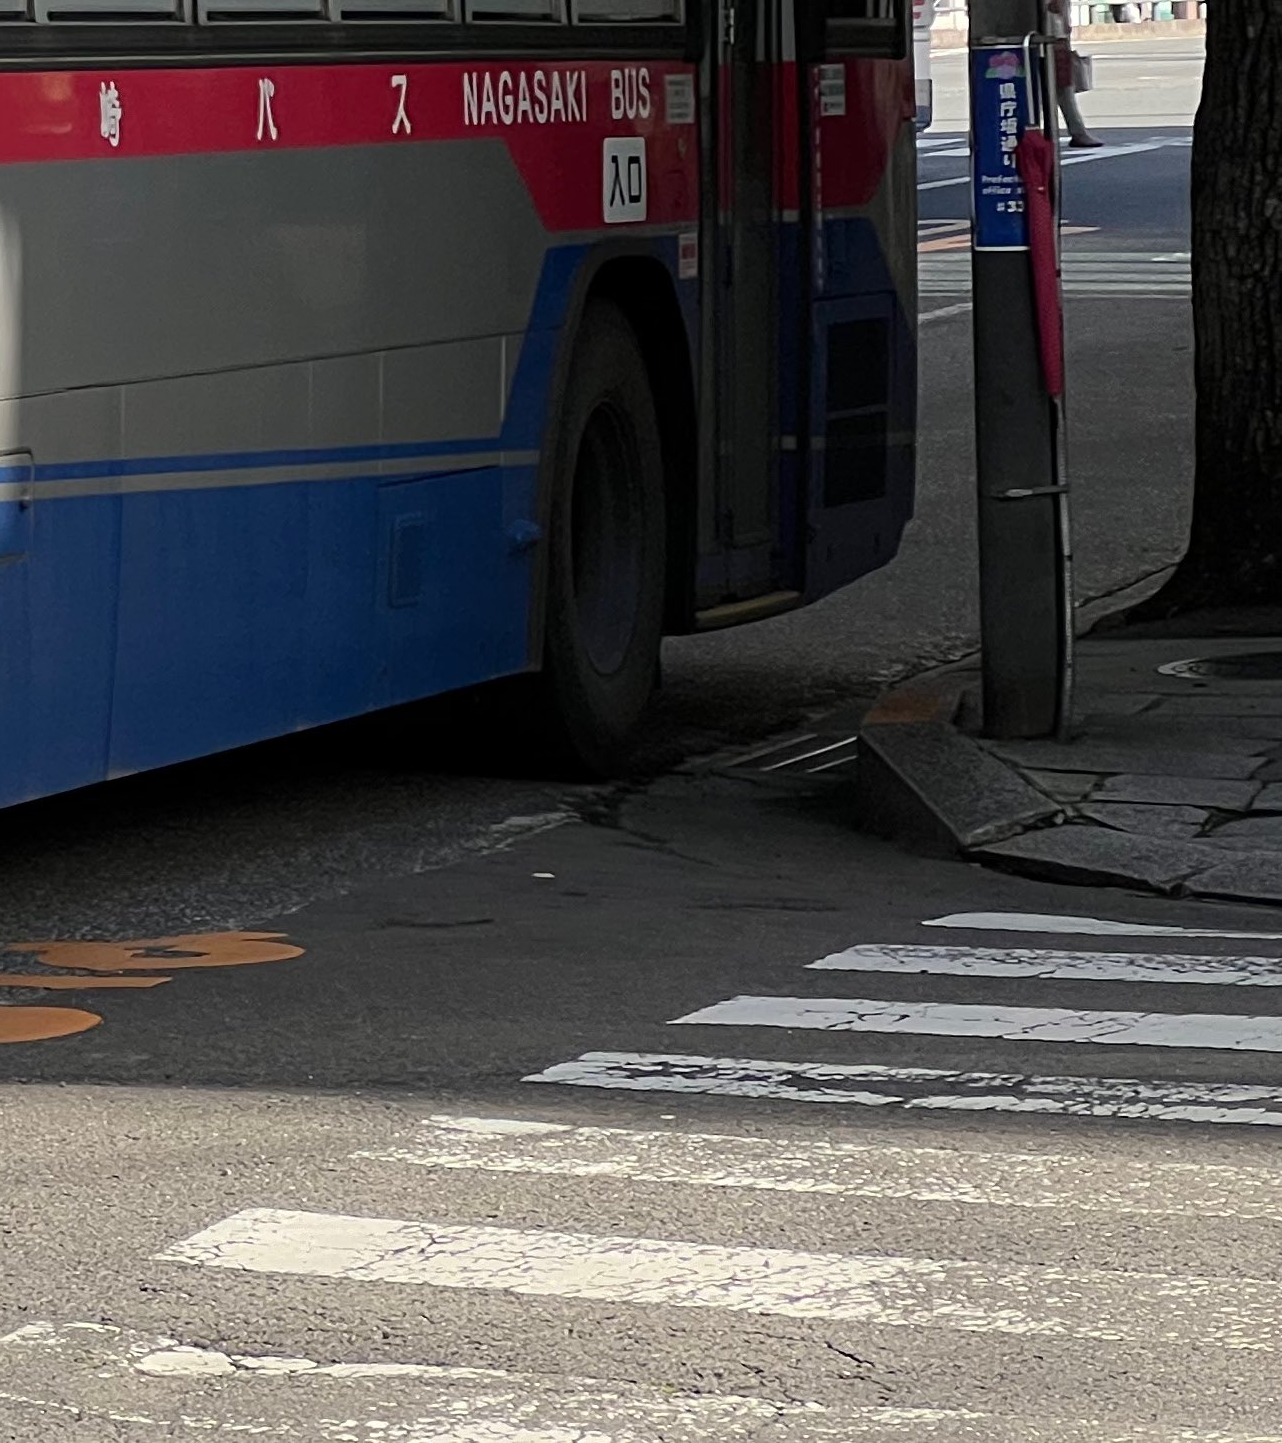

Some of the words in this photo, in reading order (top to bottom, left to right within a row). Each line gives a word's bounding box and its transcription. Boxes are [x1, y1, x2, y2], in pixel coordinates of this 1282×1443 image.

[462, 70, 588, 126] NAGASAKI
[610, 67, 652, 120] BUS
[609, 154, 642, 208] 入口
